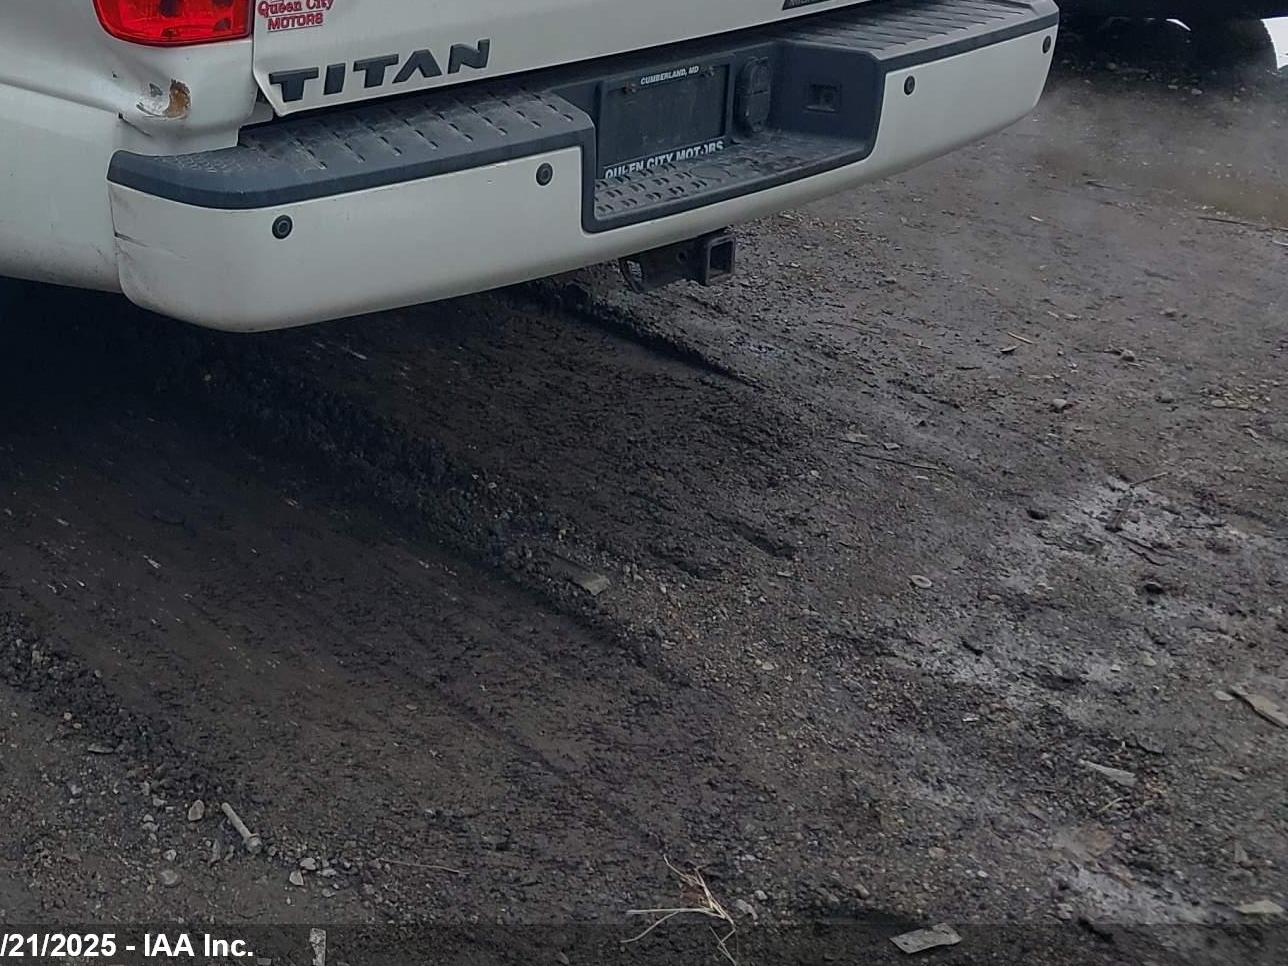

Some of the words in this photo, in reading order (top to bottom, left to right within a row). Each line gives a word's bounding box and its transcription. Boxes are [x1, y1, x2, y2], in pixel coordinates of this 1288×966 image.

[257, 0, 303, 18] Queen
[267, 12, 324, 31] MOTORS
[268, 38, 490, 103] TITAN
[640, 67, 688, 86] CUMBERLAND,
[688, 65, 700, 75] MD
[646, 152, 674, 170] CITY
